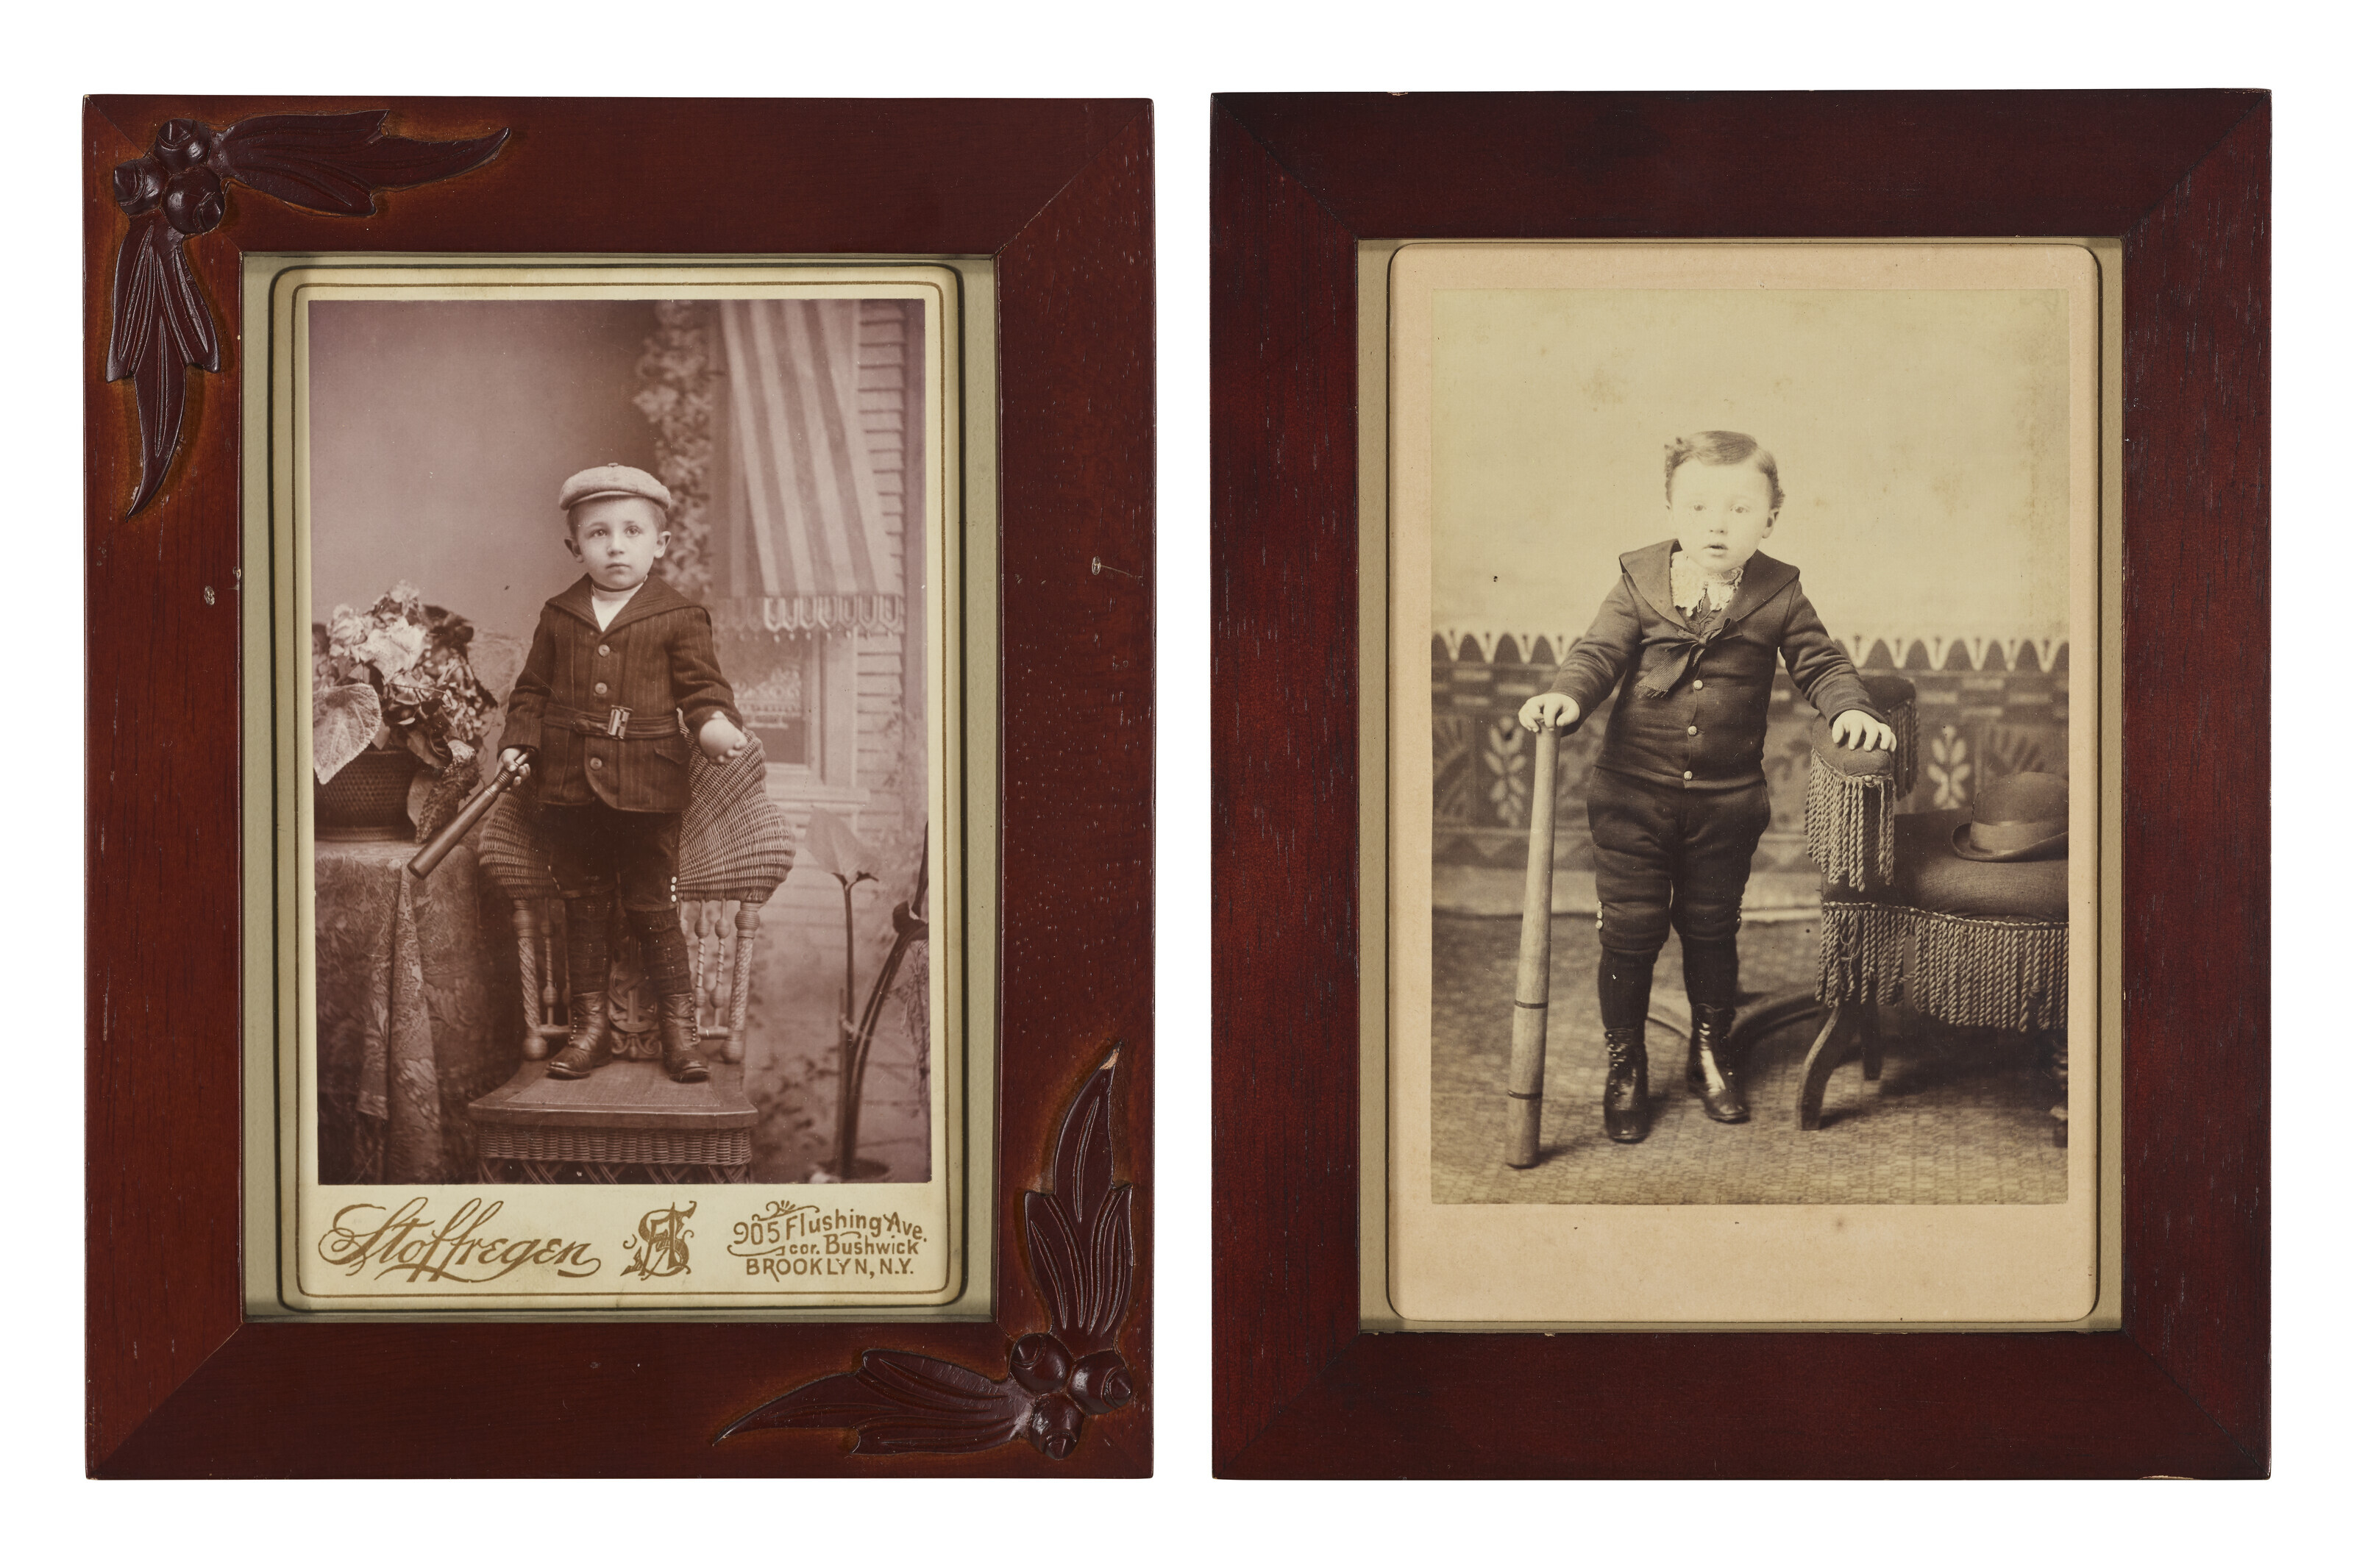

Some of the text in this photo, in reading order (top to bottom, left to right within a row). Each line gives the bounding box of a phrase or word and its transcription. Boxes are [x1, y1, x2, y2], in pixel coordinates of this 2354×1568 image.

[318, 1197, 601, 1283] Stoffregen
[733, 1208, 928, 1245] 905 Flushing Ave.
[789, 1233, 920, 1255] cor. Bushwick
[745, 1258, 914, 1283] BROOKLYN, N.Y.
